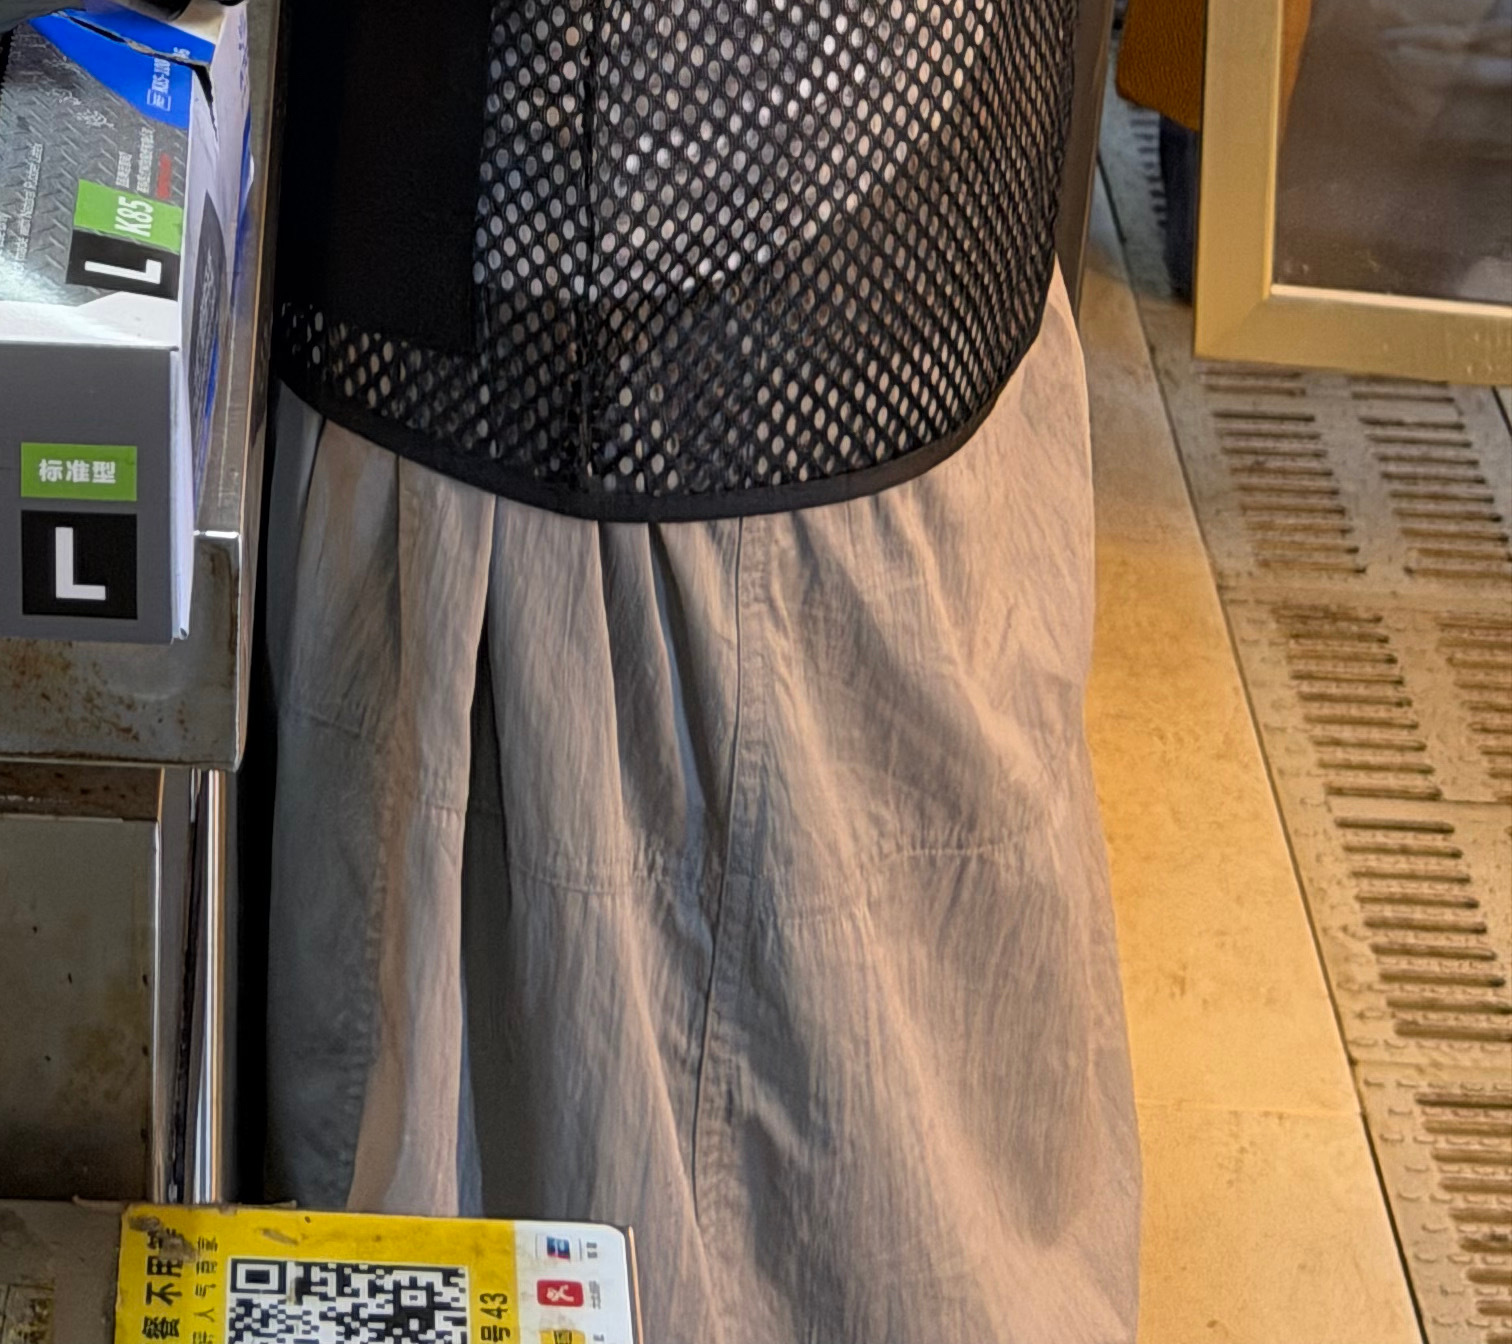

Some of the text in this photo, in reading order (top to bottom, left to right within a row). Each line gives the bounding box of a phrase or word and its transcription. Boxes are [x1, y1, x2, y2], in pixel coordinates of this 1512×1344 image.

[114, 196, 154, 237] K85
[85, 259, 162, 285] L
[39, 458, 116, 484] 标准型
[55, 527, 106, 601] L
[480, 1293, 508, 1320] 43
